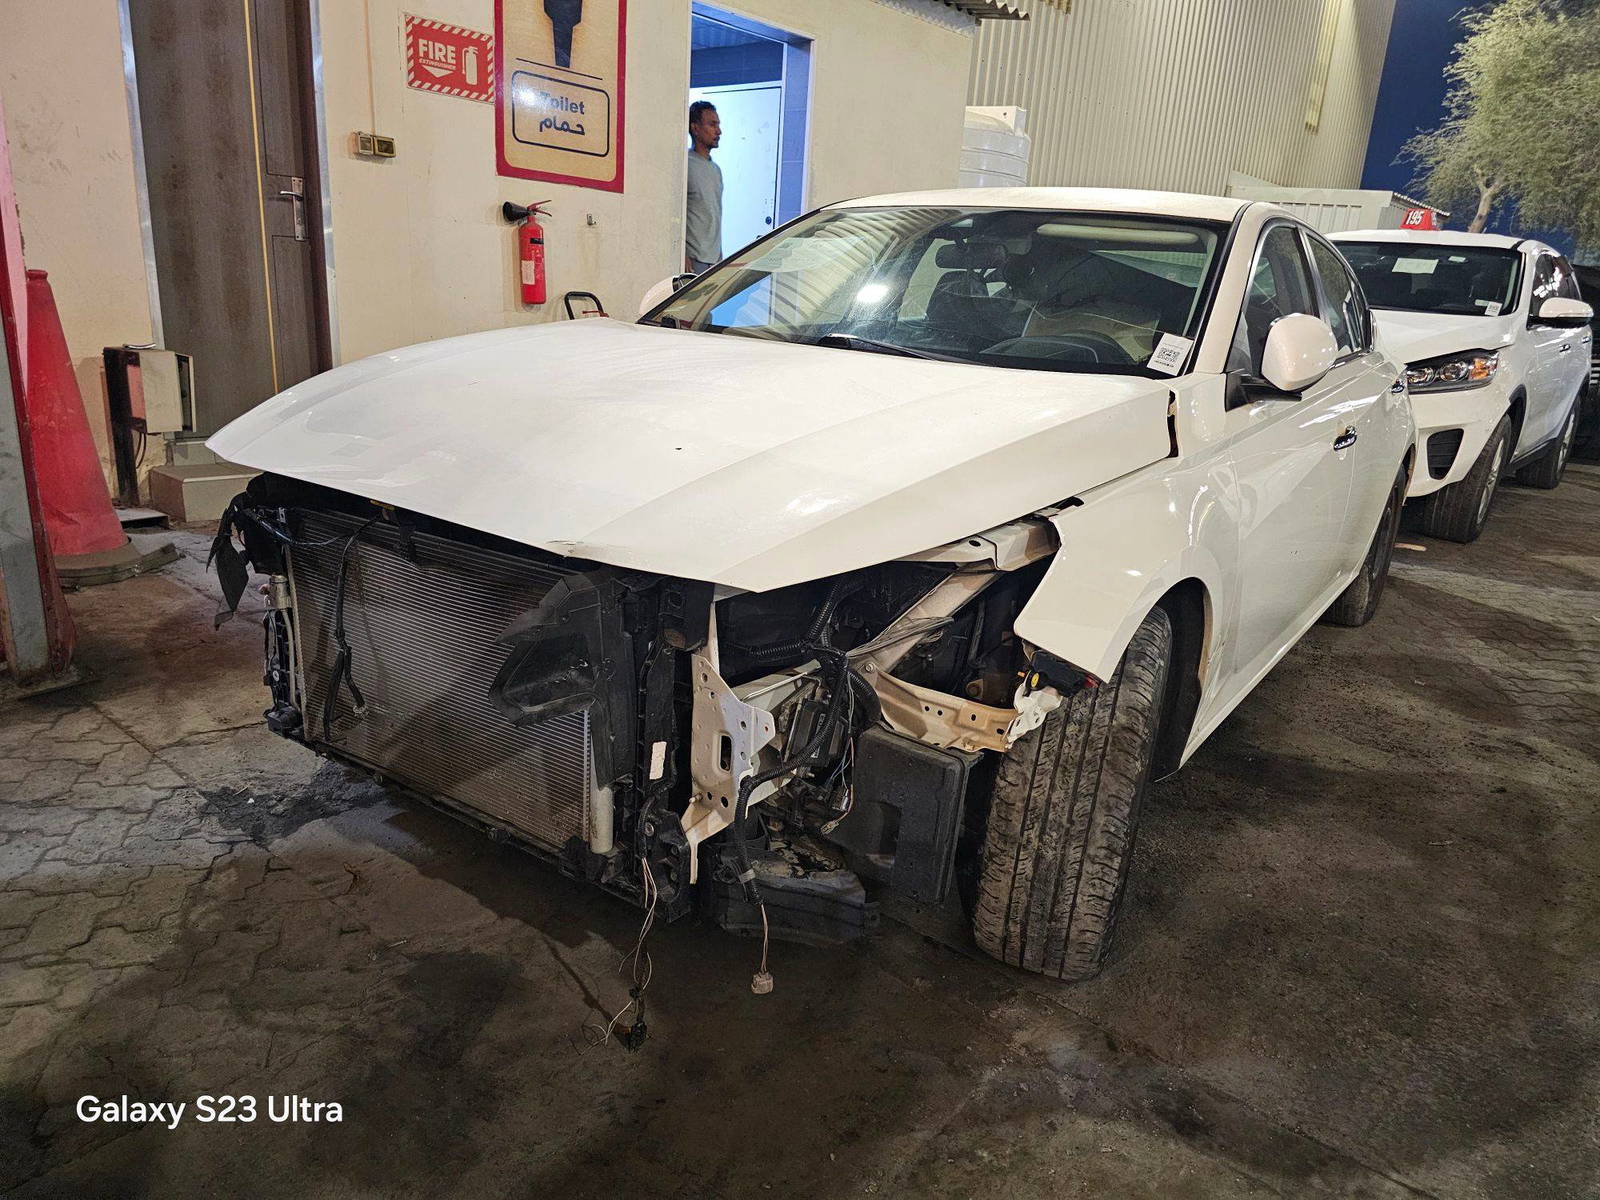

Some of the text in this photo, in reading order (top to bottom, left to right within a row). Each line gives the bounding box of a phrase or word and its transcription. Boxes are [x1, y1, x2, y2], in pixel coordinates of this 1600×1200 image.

[418, 38, 457, 65] FIRE
[418, 57, 457, 71] EXTINGUISH
[540, 91, 585, 115] Toilet
[539, 115, 586, 136] حمام
[1404, 209, 1426, 226] 195
